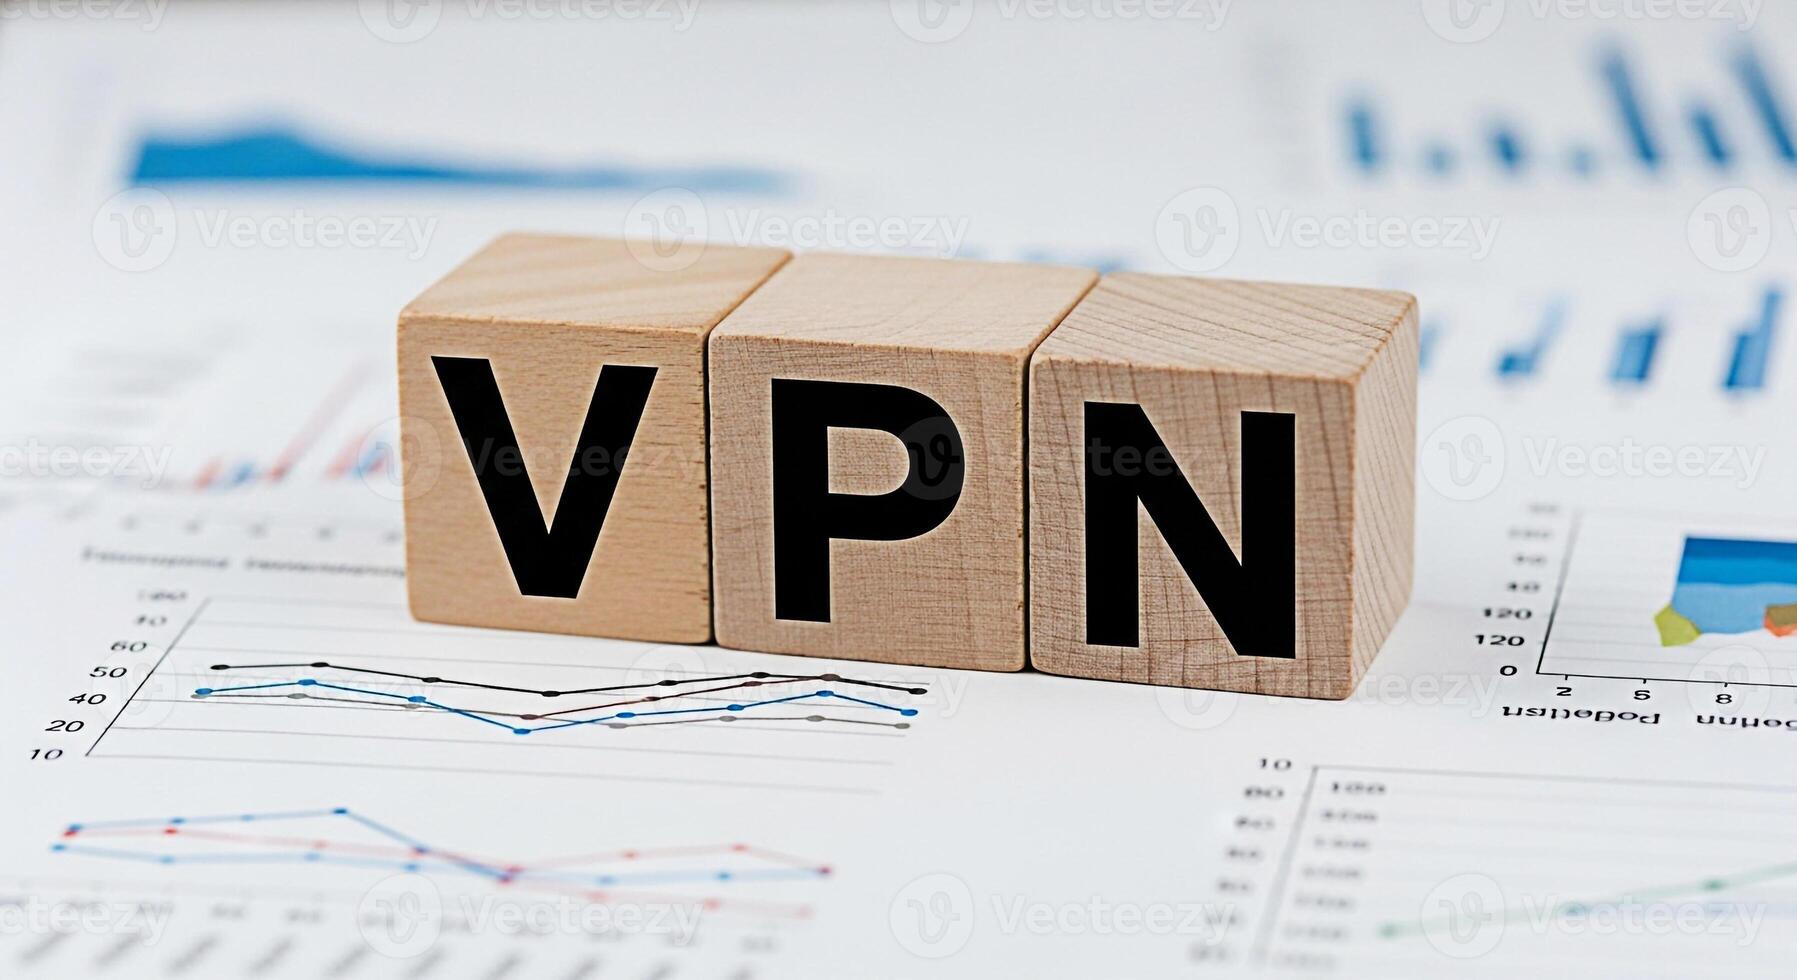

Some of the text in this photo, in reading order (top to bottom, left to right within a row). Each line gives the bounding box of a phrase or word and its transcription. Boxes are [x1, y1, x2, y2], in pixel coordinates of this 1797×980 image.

[431, 356, 1295, 659] VPN
[1475, 633, 1526, 648] 120
[88, 665, 128, 679] 50
[1498, 664, 1518, 678] 0
[67, 692, 107, 706] 40
[1556, 686, 1573, 697] 2
[1715, 693, 1733, 705] 8
[44, 719, 85, 733] 20
[30, 747, 64, 761] 10
[1259, 757, 1293, 770] 10
